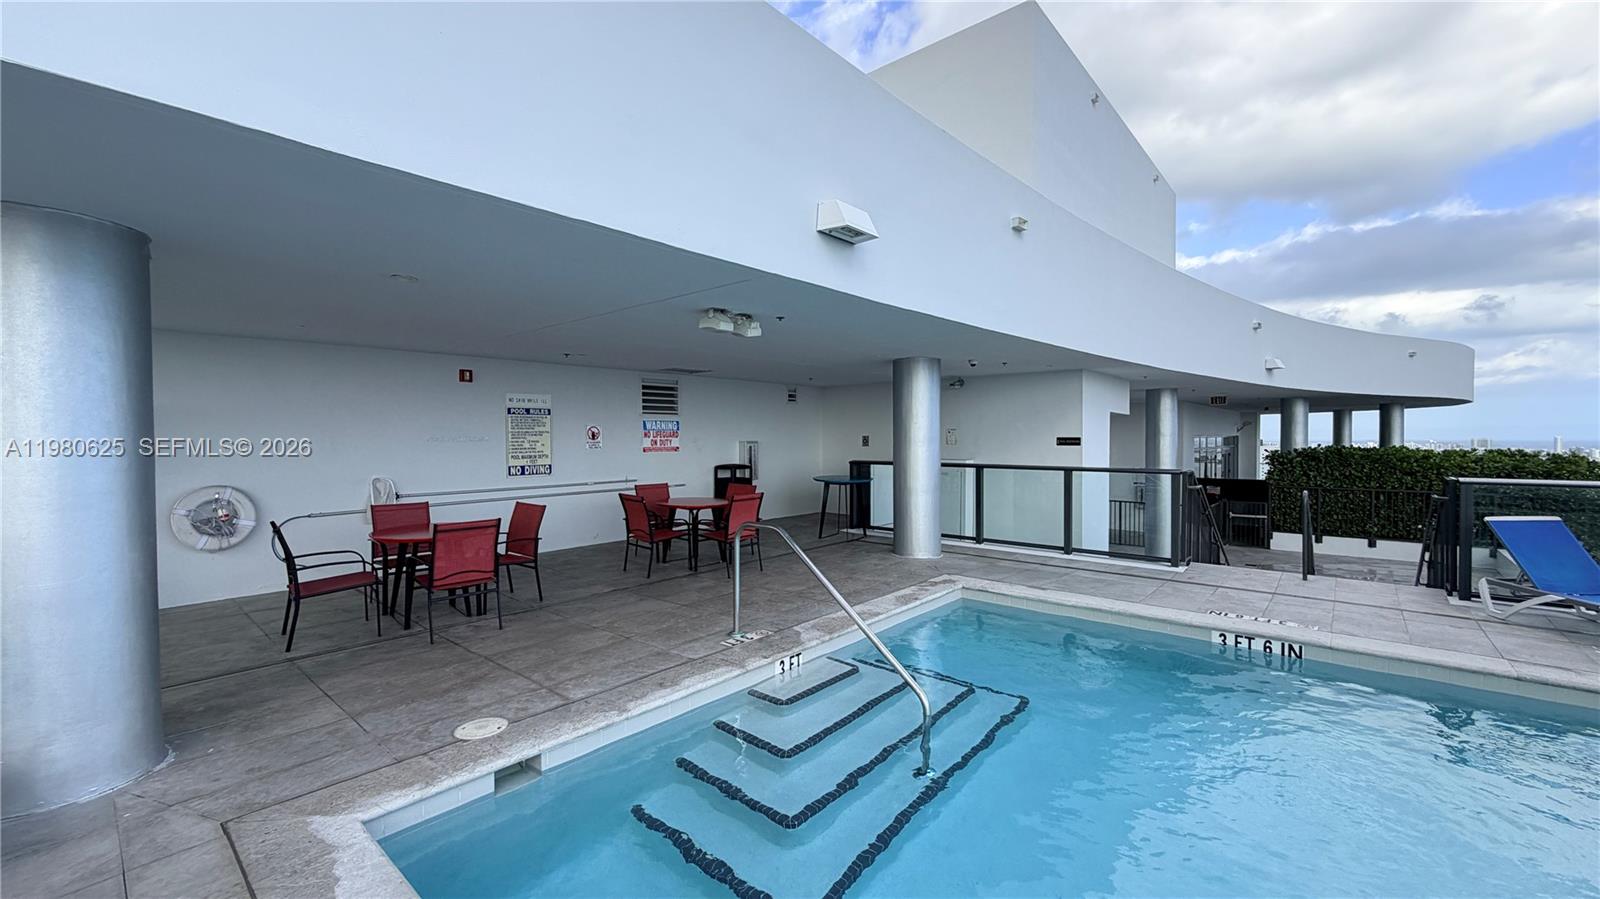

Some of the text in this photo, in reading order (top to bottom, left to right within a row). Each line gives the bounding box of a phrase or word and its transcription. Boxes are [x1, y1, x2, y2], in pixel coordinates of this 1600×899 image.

[645, 420, 678, 430] WARNING
[652, 430, 679, 438] LIFEGUARD
[650, 438, 658, 446] ON
[510, 465, 550, 475] NO DIVING
[1218, 633, 1303, 659] 3 FT 6 IN
[779, 652, 802, 674] 3 FT
